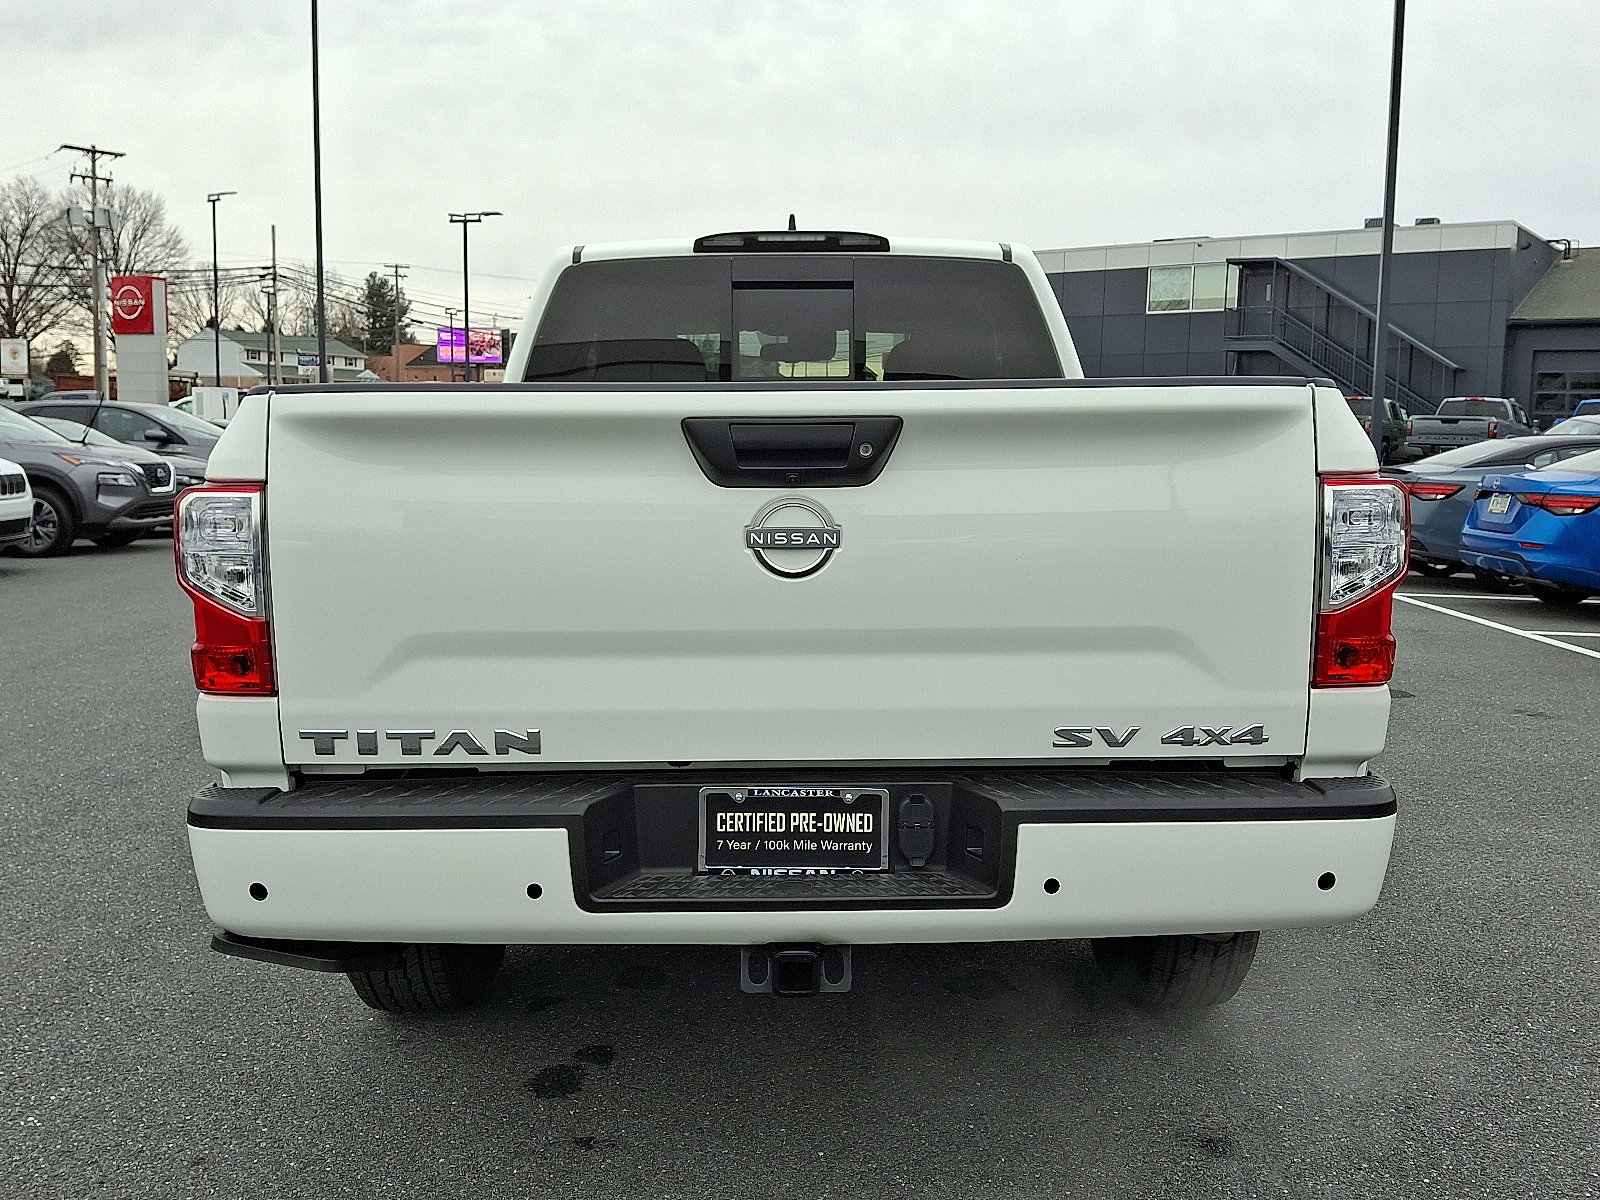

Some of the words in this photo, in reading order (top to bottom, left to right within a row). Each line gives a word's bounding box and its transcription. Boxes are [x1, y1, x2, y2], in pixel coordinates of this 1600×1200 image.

[114, 298, 145, 306] NISSAN
[750, 532, 837, 545] NISSAN
[299, 729, 542, 756] TITAN
[1052, 725, 1141, 748] SV
[753, 789, 835, 797] LANCASTER
[716, 812, 786, 833] CERTIFIED
[790, 812, 873, 833] PRE-OWNED
[716, 839, 724, 850] 7
[726, 839, 752, 851] Year
[754, 839, 761, 851] /
[763, 839, 791, 851] 100k
[793, 839, 818, 851] Mile
[820, 839, 873, 854] Warranty
